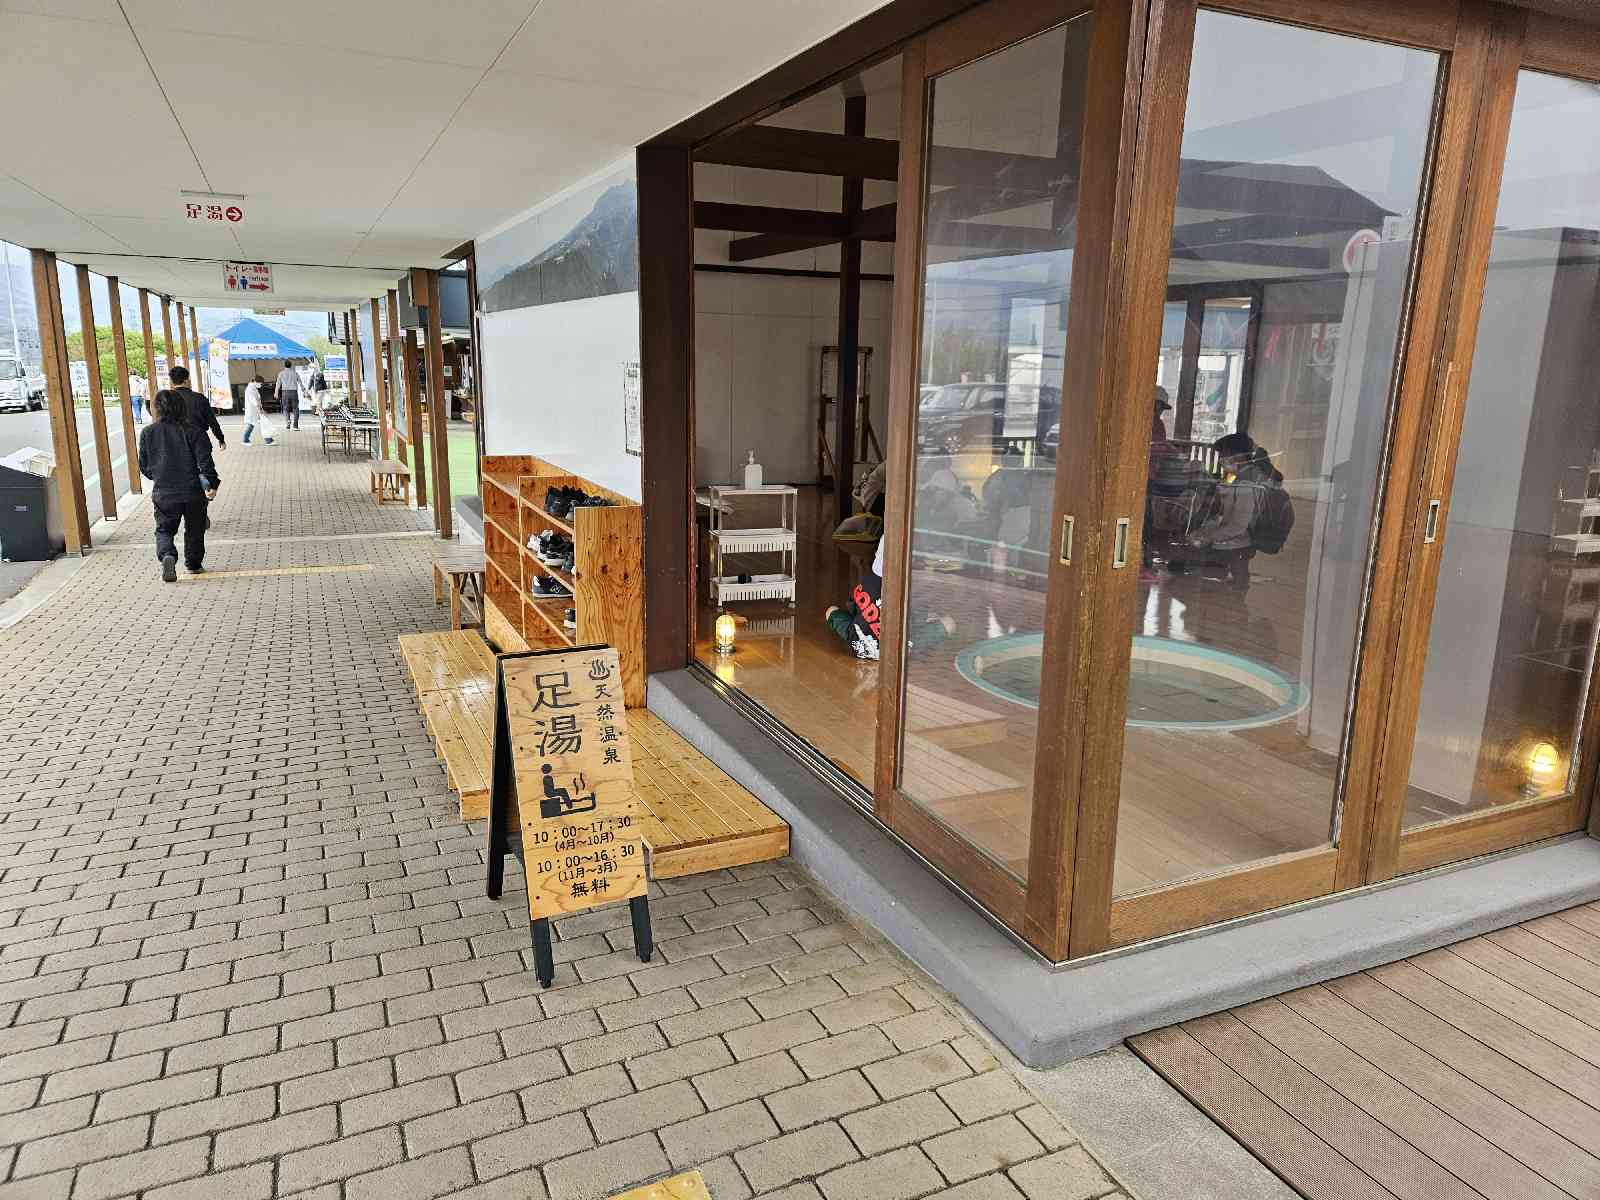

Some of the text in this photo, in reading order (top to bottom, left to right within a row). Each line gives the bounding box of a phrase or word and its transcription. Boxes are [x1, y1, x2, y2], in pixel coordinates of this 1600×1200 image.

[531, 671, 583, 758] 足湯
[594, 683, 622, 765] 天然温泉
[570, 877, 611, 900] 無料
